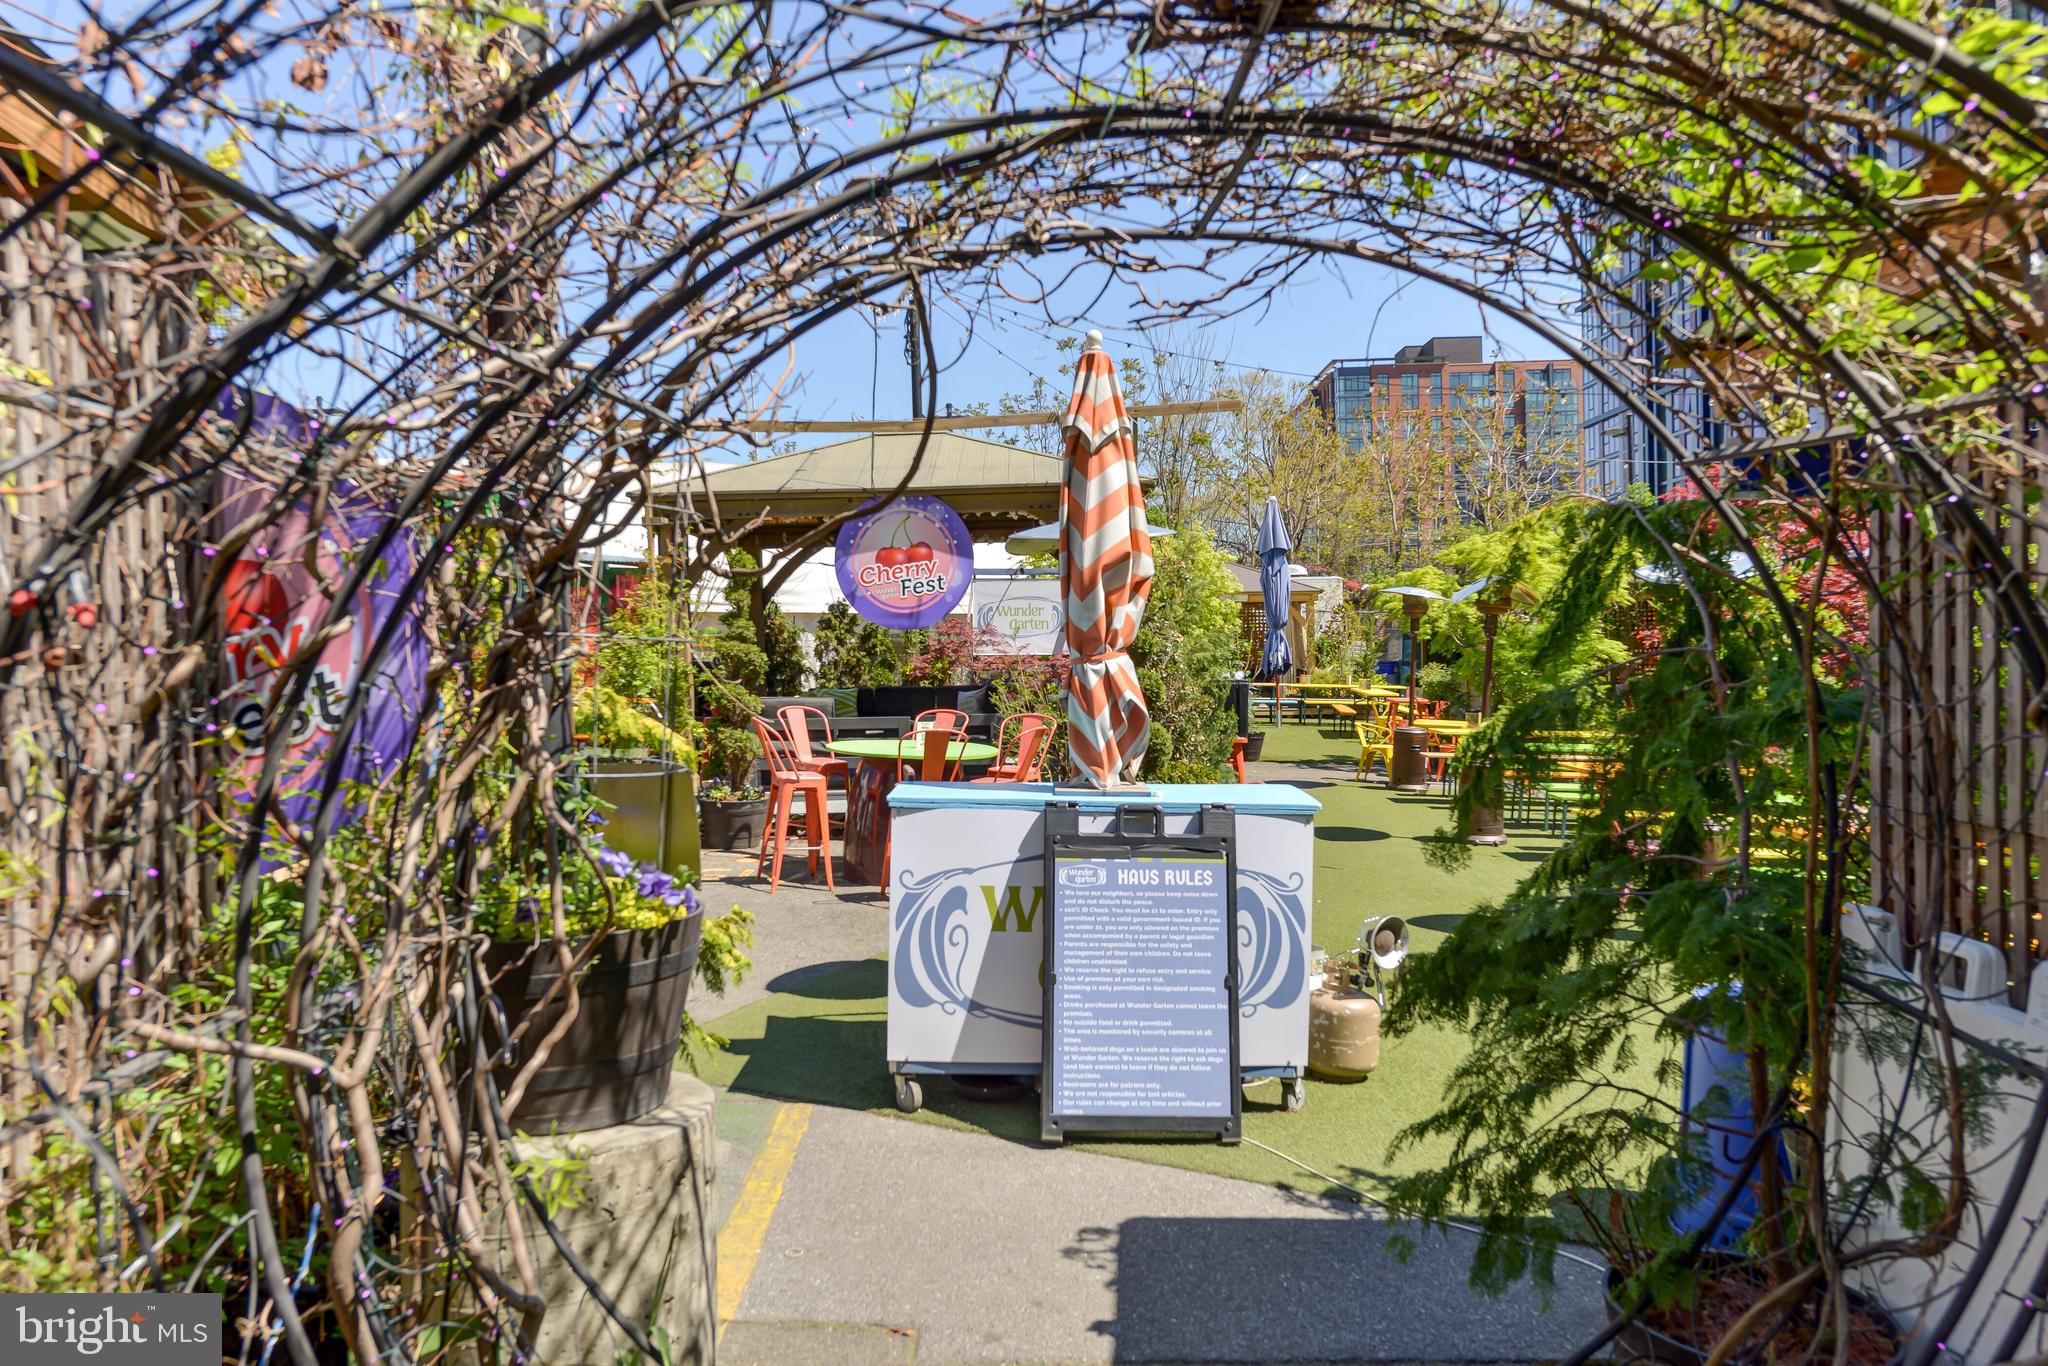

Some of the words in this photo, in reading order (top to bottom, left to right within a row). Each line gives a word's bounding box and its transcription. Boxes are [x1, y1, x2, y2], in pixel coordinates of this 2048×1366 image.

[859, 560, 937, 586] Cherry
[901, 574, 946, 599] Fest
[997, 603, 1044, 616] Wunder
[1009, 618, 1049, 634] garten
[1069, 867, 1094, 876] Wunder
[1075, 875, 1097, 885] garten
[1118, 868, 1159, 885] HAUS
[1165, 869, 1213, 886] RULES
[1144, 890, 1165, 898] please
[1166, 891, 1181, 899] keep
[1186, 908, 1202, 916] Entry
[1203, 908, 1217, 916] only
[1063, 915, 1094, 923] permitted
[1129, 924, 1142, 932] only
[1191, 925, 1219, 933] premises
[1082, 932, 1123, 940] accompanied
[1139, 933, 1160, 941] parent
[1168, 933, 1184, 941] legal
[1100, 941, 1136, 949] responsible
[1159, 942, 1178, 950] safety
[1063, 950, 1104, 958] management
[1112, 967, 1126, 975] right
[1157, 968, 1174, 976] entry
[1122, 976, 1136, 984] your
[1063, 984, 1090, 992] Smoking
[1098, 984, 1112, 992] only
[1113, 984, 1144, 992] permitted
[1152, 985, 1188, 993] designated
[1189, 985, 1216, 993] smoking
[1084, 1002, 1117, 1010] purchased
[1141, 1029, 1166, 1037] security
[1109, 1046, 1124, 1054] dogs
[1205, 1047, 1217, 1055] join
[1170, 1055, 1186, 1063] right
[1207, 1056, 1223, 1064] dogs
[1153, 1064, 1168, 1072] they
[1120, 1082, 1144, 1090] patrons
[1098, 1091, 1136, 1099] responsible
[1206, 1100, 1221, 1108] prior
